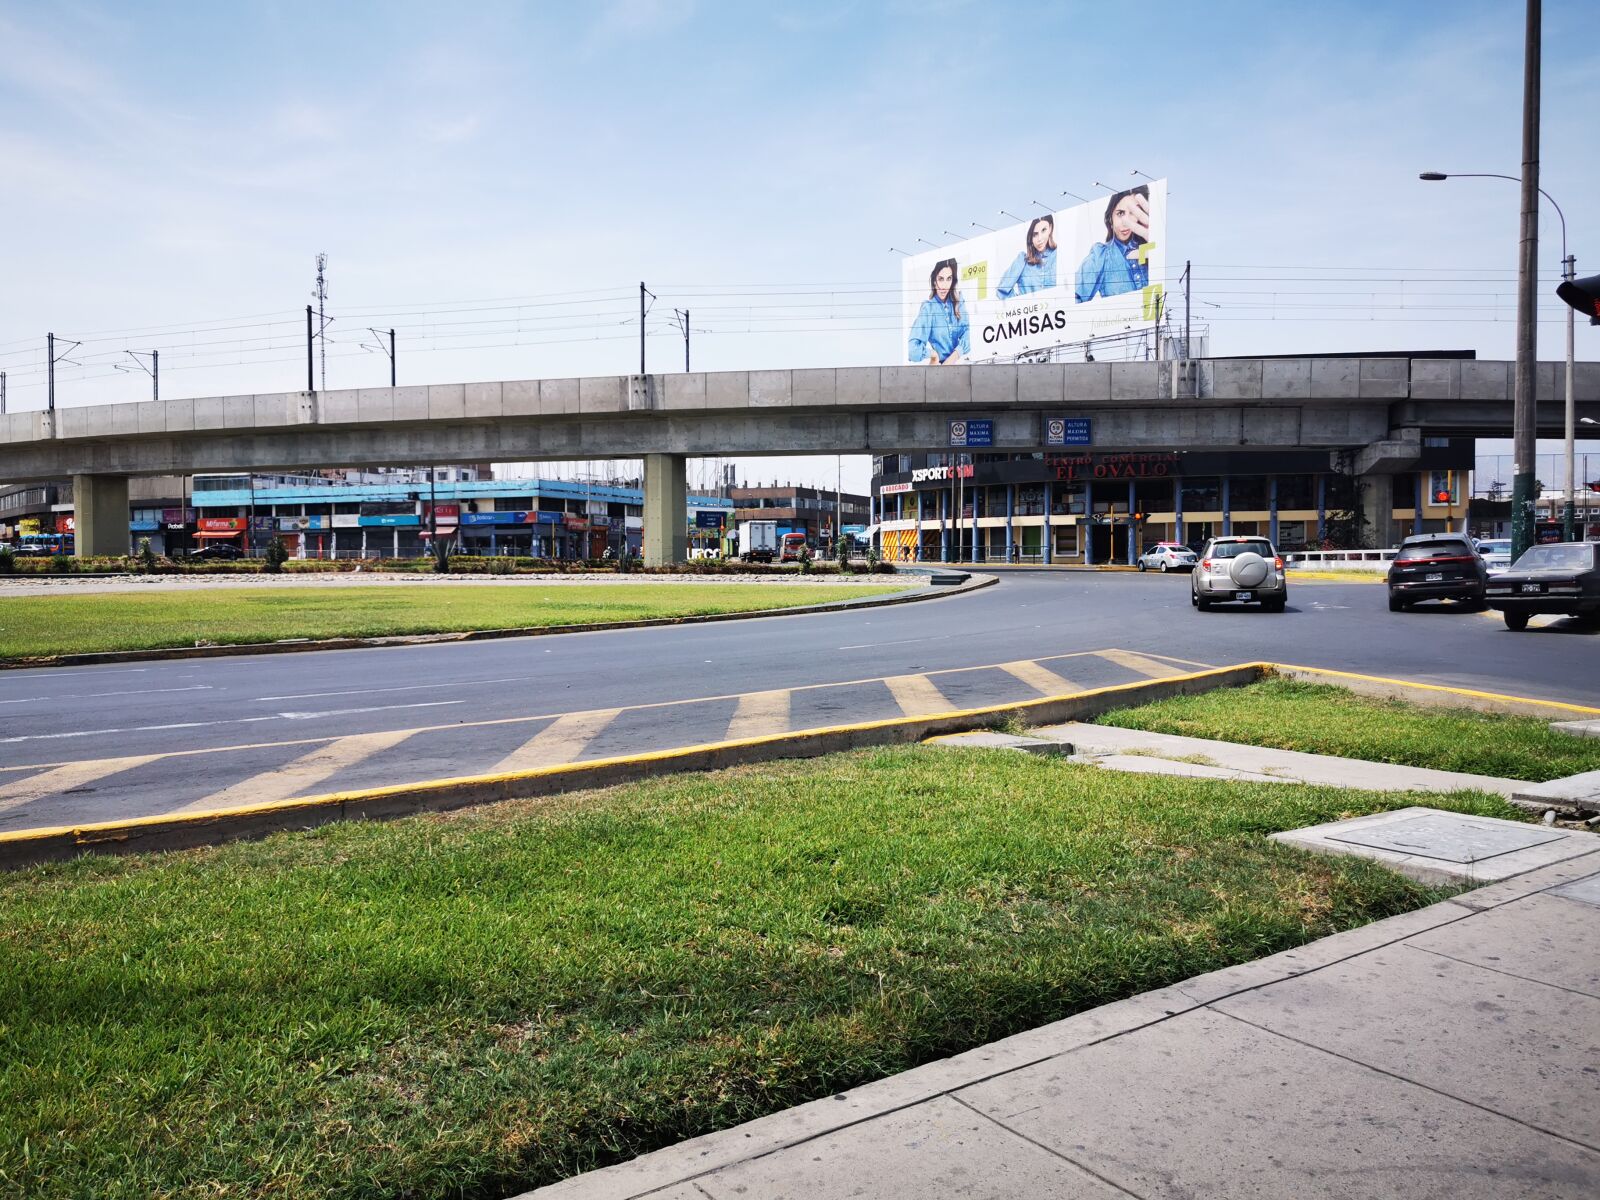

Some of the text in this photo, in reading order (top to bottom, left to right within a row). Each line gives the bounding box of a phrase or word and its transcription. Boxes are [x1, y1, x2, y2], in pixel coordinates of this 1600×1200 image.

[1023, 304, 1039, 314] QUE
[983, 310, 1066, 343] CAMISAS
[1101, 453, 1181, 463] COMERCIAL
[1056, 463, 1167, 480] EL OVALO
